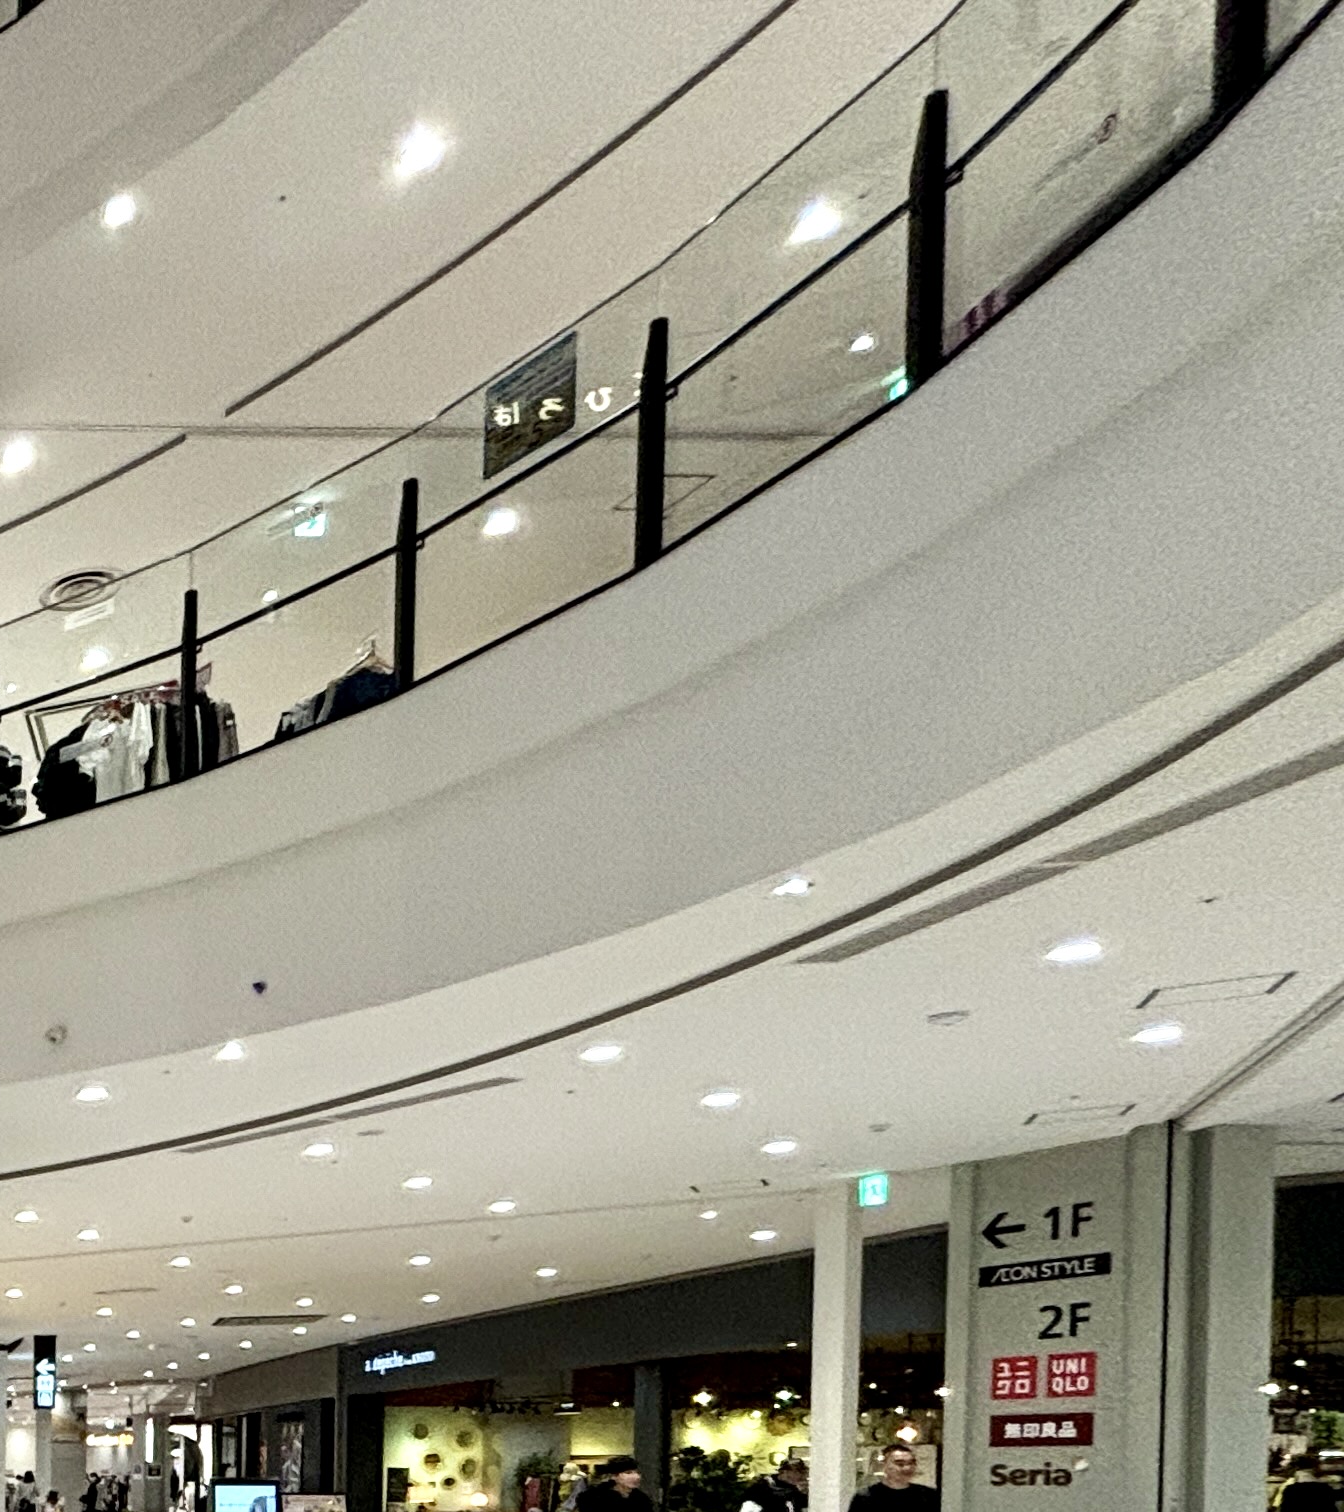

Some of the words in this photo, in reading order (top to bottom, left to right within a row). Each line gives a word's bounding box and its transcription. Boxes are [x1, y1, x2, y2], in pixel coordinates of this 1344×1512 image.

[1043, 1201, 1094, 1241] 1F
[1040, 1257, 1097, 1278] STYLE
[1037, 1302, 1092, 1340] 2F
[1051, 1357, 1087, 1374] UNI
[1051, 1375, 1089, 1393] QLO
[1003, 1420, 1078, 1439] 無印良品
[990, 1462, 1073, 1487] Seria
